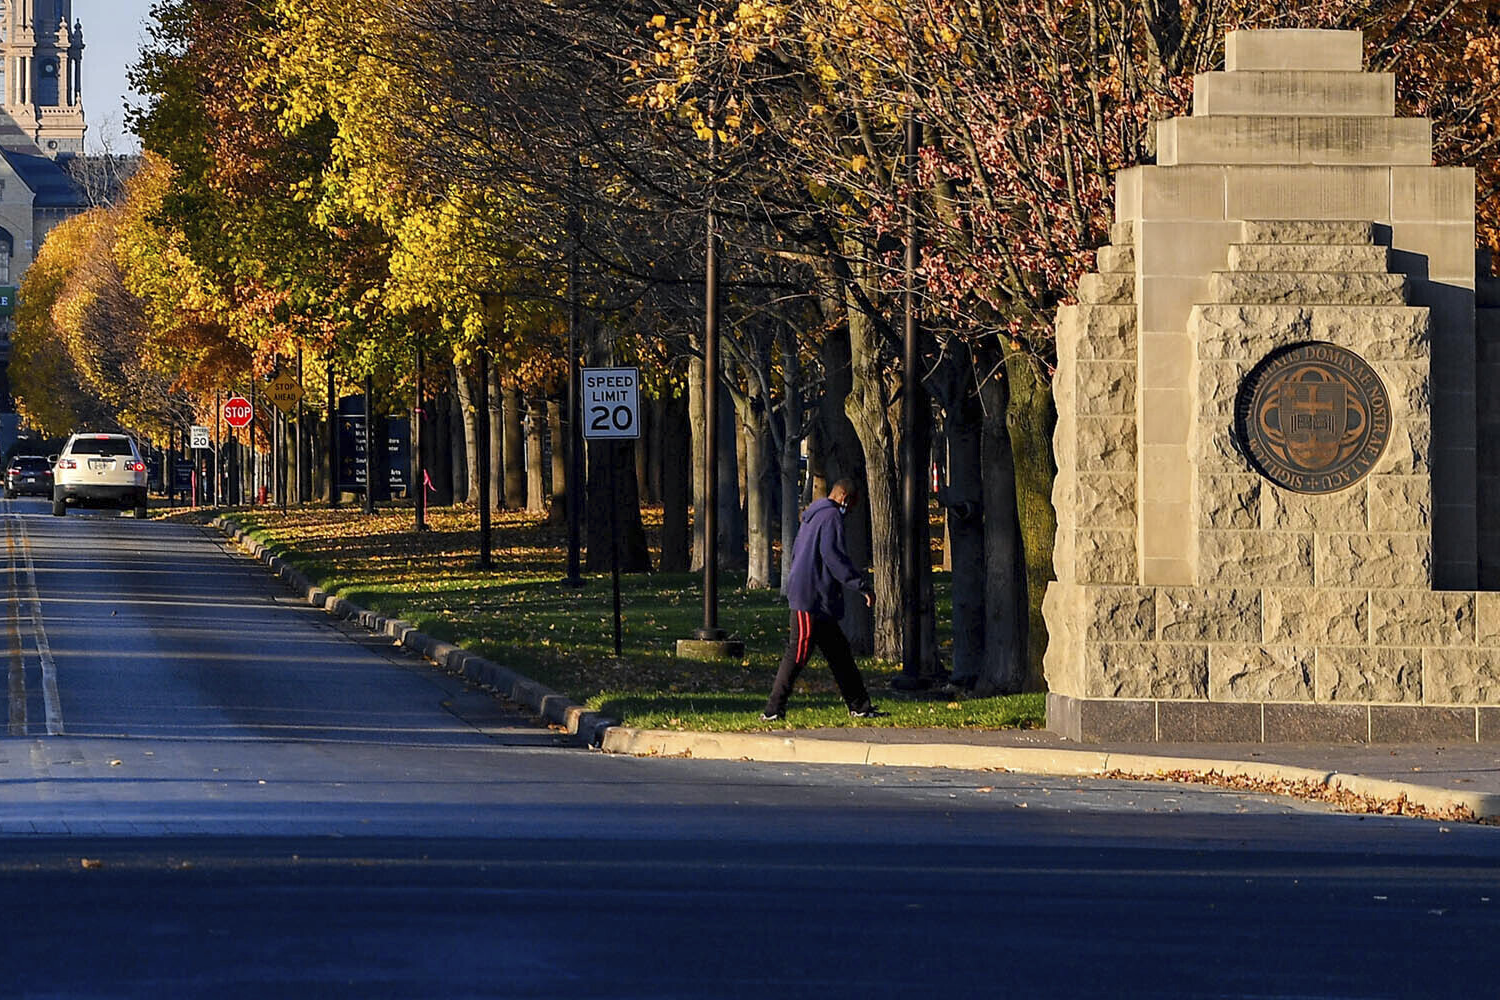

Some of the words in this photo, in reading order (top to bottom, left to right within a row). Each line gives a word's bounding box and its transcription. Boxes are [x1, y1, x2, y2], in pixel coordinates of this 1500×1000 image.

[1305, 345, 1373, 385] DOMINAE
[587, 376, 633, 388] SPEED
[274, 392, 296, 400] AHEAD
[592, 391, 628, 402] LIMIT
[225, 407, 251, 418] STOP
[590, 405, 633, 431] 20
[1366, 385, 1386, 457] NOSTRAE
[193, 437, 207, 446] 20
[1321, 463, 1362, 489] LACU
